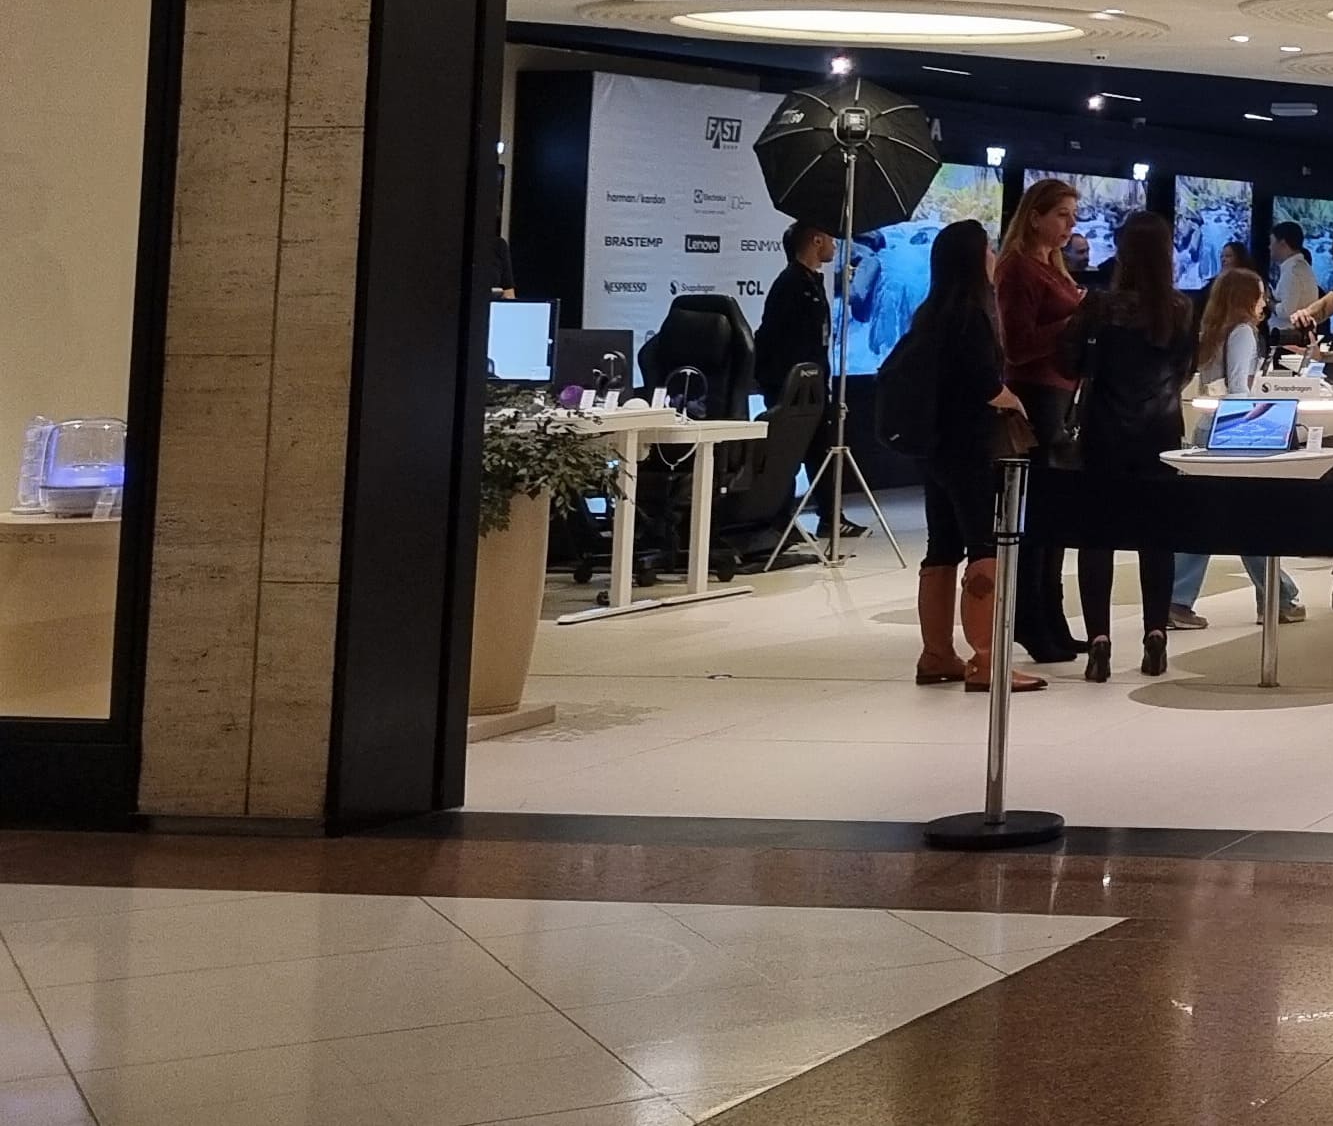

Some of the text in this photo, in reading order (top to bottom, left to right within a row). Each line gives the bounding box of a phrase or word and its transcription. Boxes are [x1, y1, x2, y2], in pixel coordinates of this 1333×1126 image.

[706, 117, 742, 149] FAST
[604, 236, 664, 248] BRASTEMP
[686, 236, 720, 252] Lenovo
[736, 280, 765, 296] TCL
[1273, 384, 1313, 393] Snapdragon
